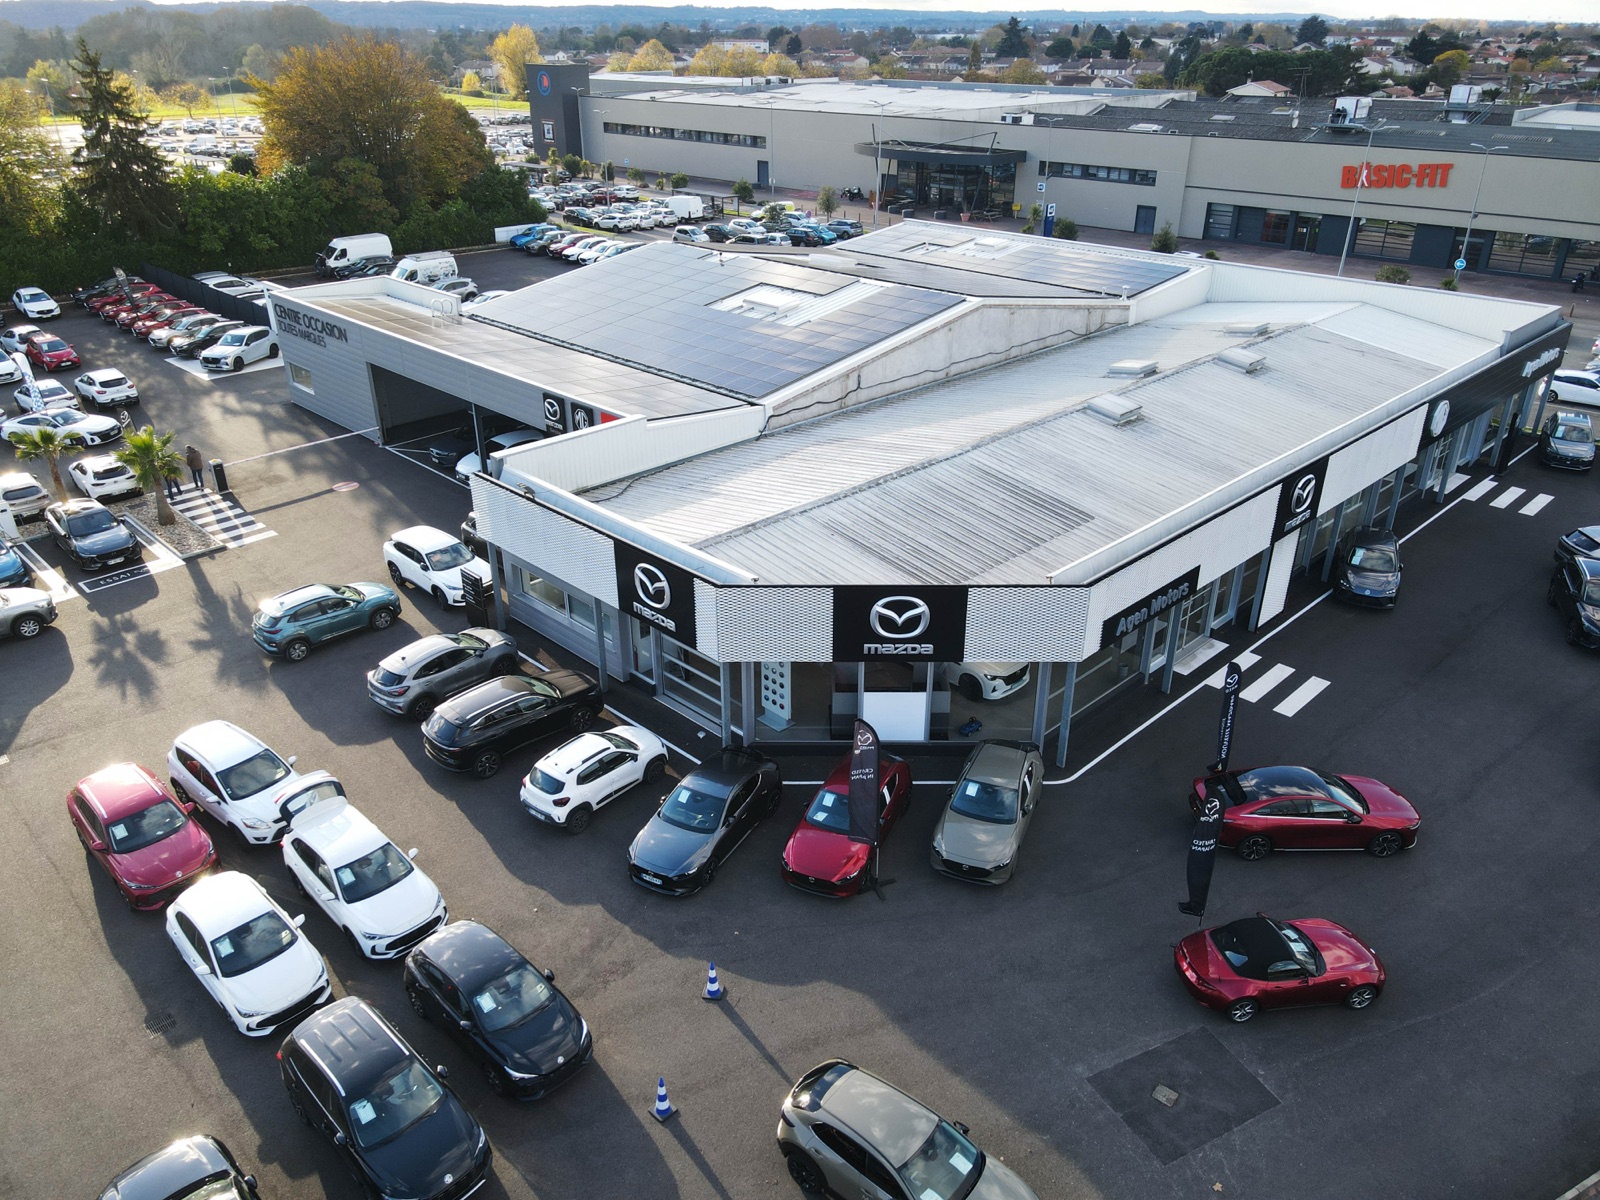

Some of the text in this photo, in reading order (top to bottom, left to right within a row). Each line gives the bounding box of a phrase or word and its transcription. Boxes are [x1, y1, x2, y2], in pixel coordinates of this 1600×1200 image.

[302, 313, 348, 343] OCCASION
[99, 572, 131, 585] ESSAI
[632, 601, 677, 633] mazda
[1115, 582, 1190, 637] Agen Motors
[863, 643, 934, 655] mazda
